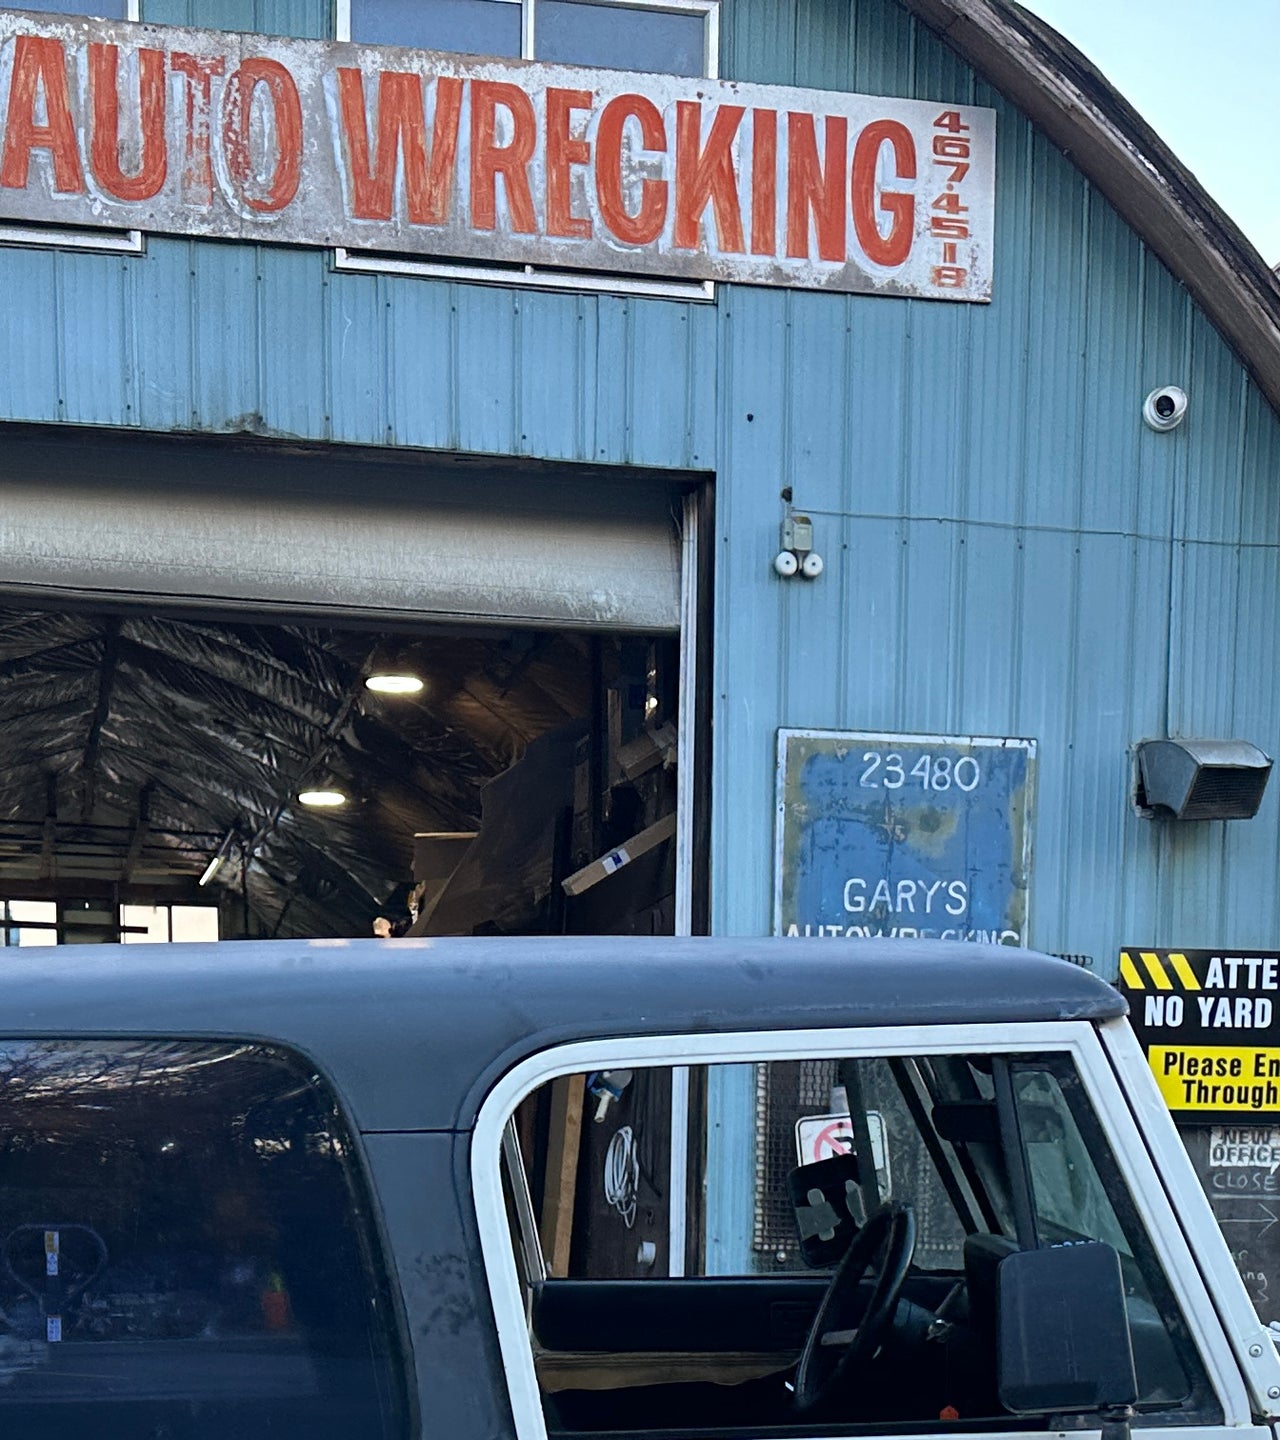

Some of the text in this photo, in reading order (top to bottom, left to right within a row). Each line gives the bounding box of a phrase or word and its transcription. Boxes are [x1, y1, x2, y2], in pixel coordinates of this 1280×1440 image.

[336, 66, 917, 267] WRECKING
[860, 752, 980, 791] 23480
[844, 878, 967, 915] GARY'S
[1144, 995, 1184, 1028] NO
[1198, 997, 1272, 1029] YARD
[1164, 1052, 1241, 1077] Please
[1182, 1079, 1278, 1109] Through
[1221, 1128, 1271, 1144] NEW
[1213, 1144, 1280, 1161] OFFICE
